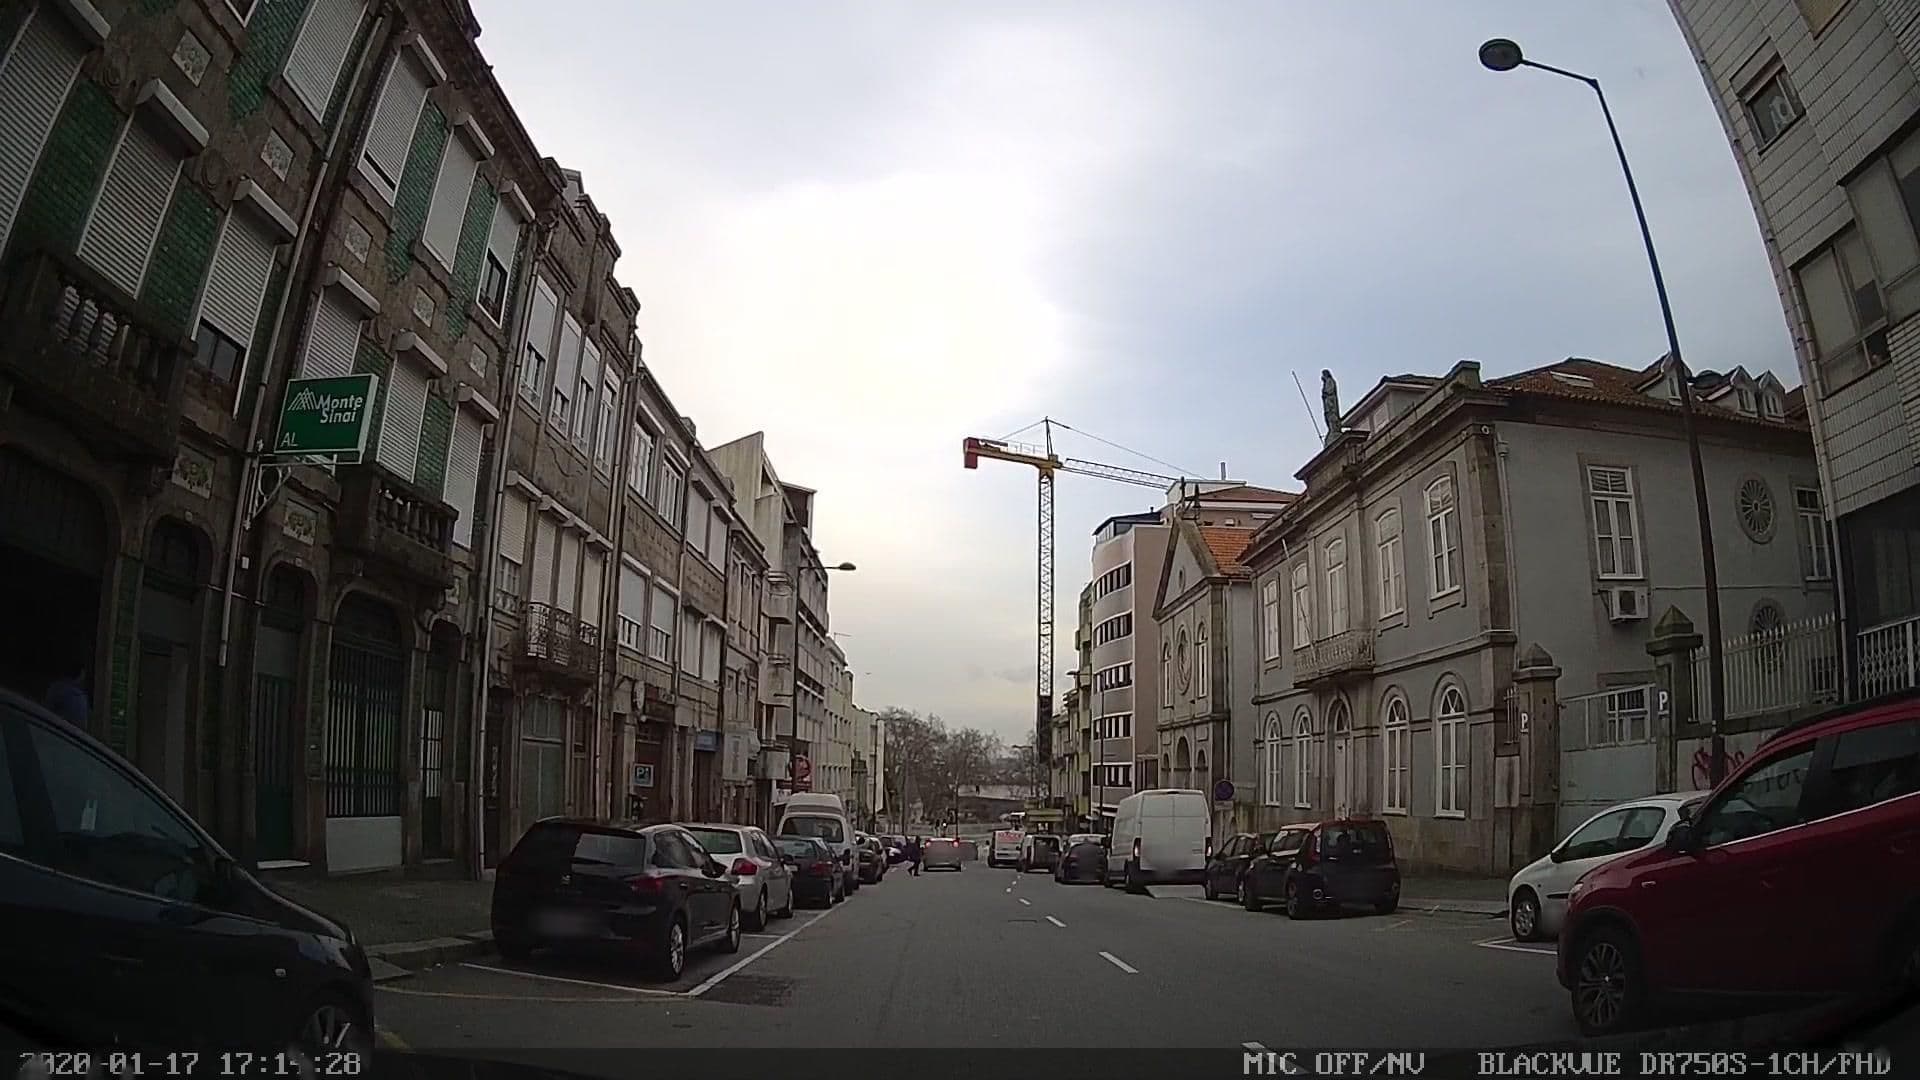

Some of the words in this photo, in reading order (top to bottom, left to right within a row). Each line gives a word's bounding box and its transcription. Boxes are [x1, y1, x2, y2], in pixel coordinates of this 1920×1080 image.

[317, 394, 363, 410] Monte
[320, 407, 357, 424] Sinai
[280, 432, 299, 447] AL
[1658, 691, 1669, 711] P
[1521, 712, 1529, 729] P
